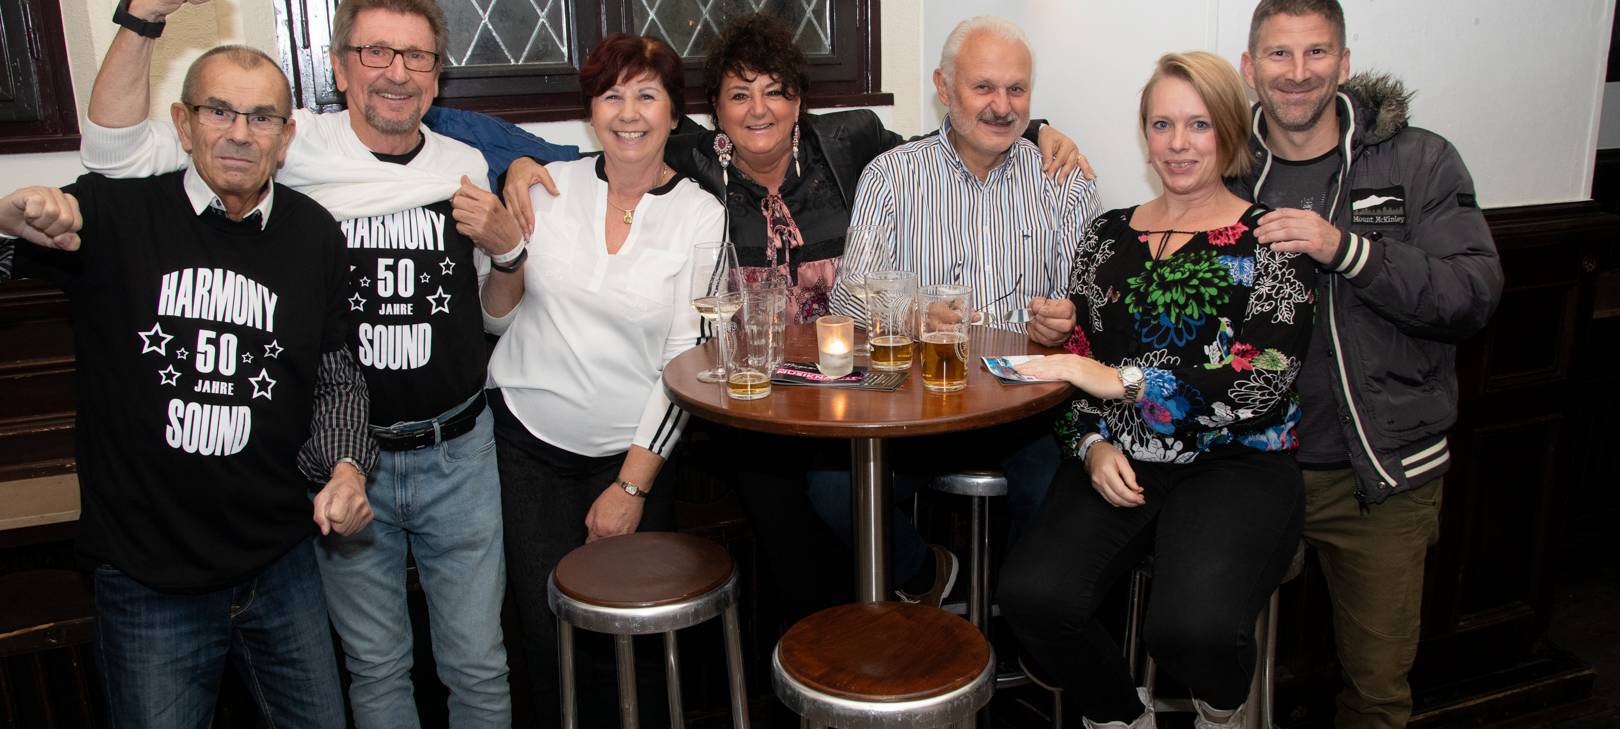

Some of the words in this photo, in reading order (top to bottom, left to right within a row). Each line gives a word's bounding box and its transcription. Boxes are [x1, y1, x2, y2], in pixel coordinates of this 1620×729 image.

[340, 206, 446, 251] HARMONY
[1352, 215, 1373, 223] Mount
[1375, 214, 1405, 223] McKinley
[157, 267, 279, 333] HARMONY
[377, 257, 415, 298] 50
[378, 303, 414, 315] JAHRE
[195, 329, 238, 377] 50
[358, 322, 432, 371] SOUND
[193, 379, 235, 396] JAHRE
[165, 398, 252, 457] SOUND
